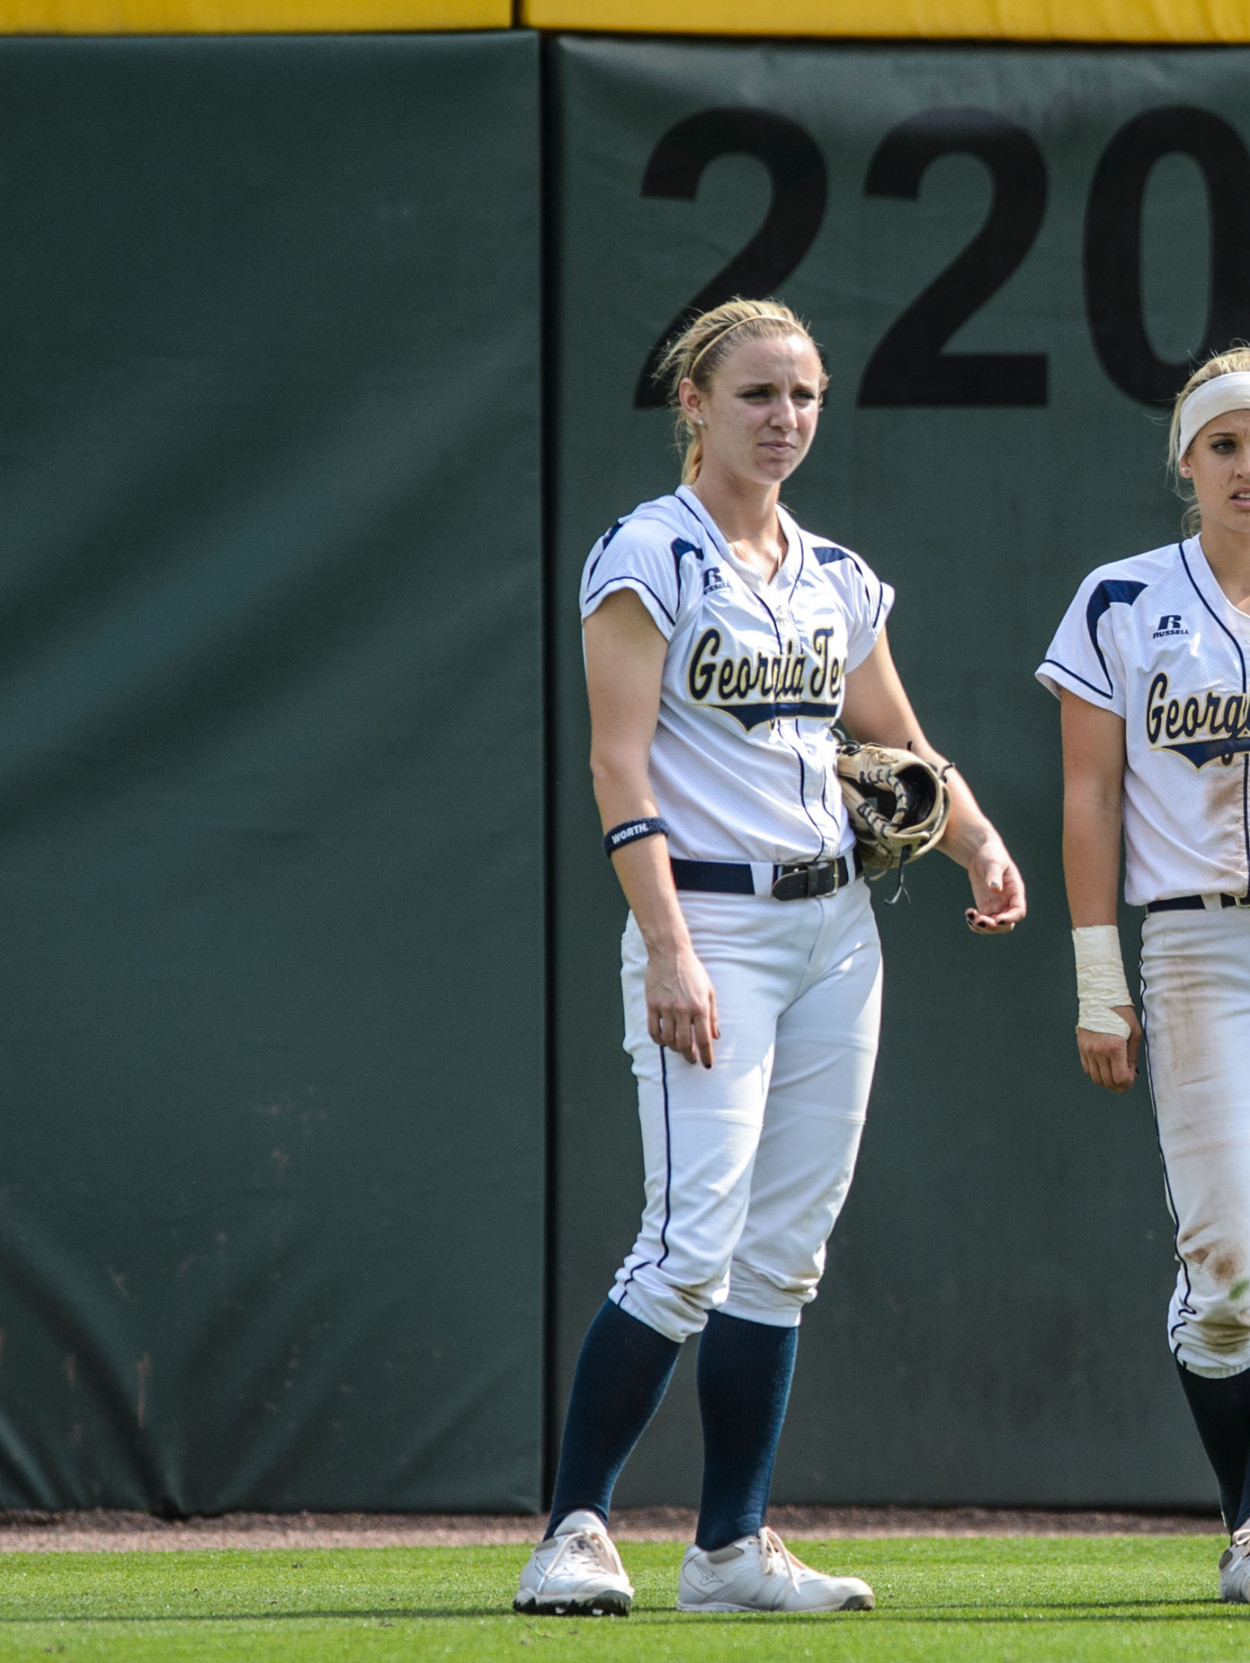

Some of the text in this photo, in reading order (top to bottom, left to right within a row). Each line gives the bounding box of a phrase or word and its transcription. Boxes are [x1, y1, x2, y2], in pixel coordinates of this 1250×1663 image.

[1152, 629, 1190, 640] RUSSELL
[688, 628, 804, 731] Georgia
[611, 822, 650, 845] WORTH
